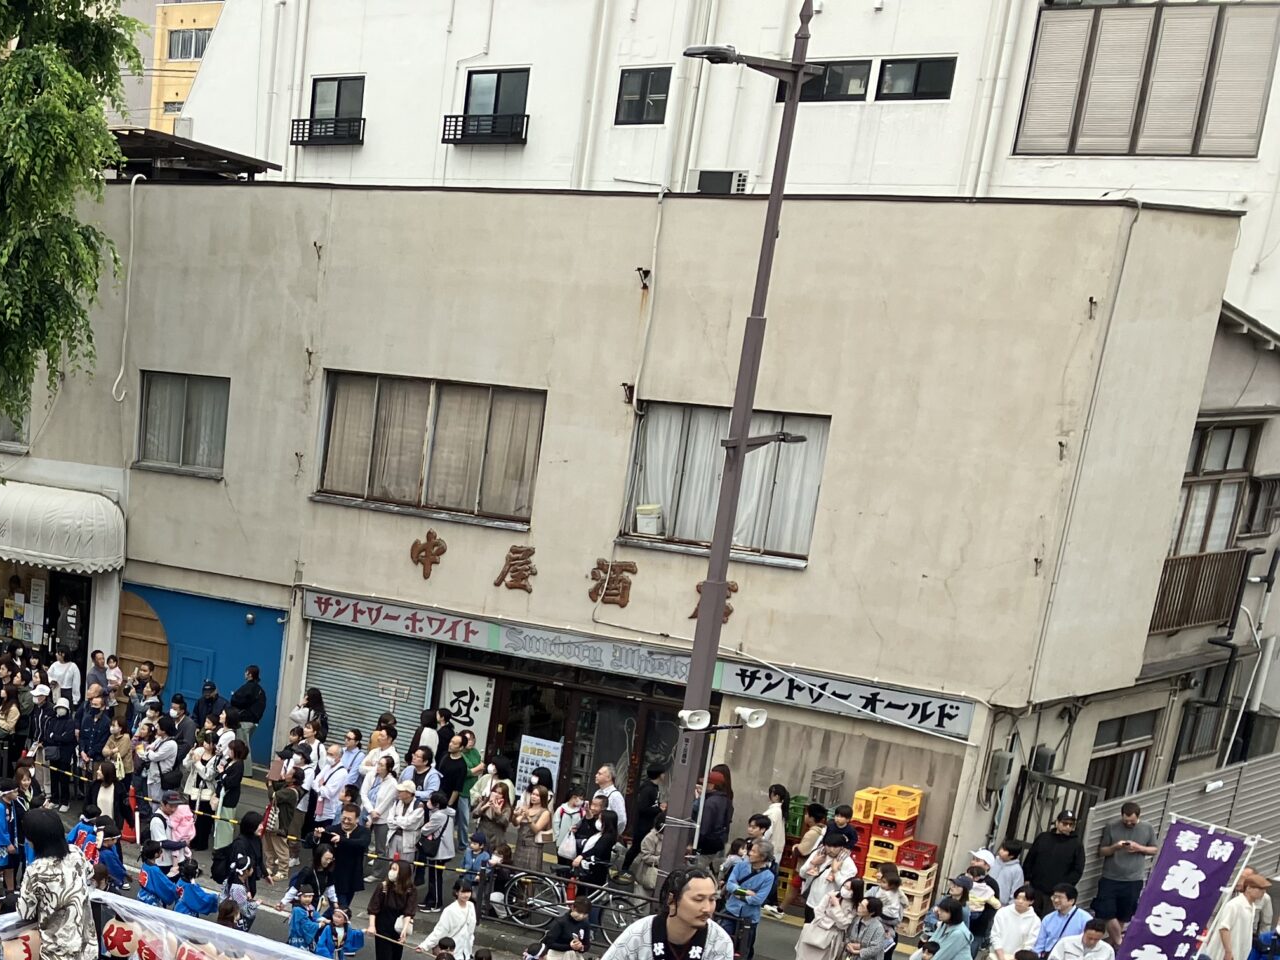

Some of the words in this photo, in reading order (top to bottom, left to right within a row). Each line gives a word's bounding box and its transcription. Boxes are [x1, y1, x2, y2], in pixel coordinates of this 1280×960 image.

[314, 596, 479, 643] サントリーホワイト
[505, 627, 604, 668] Suntory
[736, 667, 961, 729] サントリーオールド
[1175, 829, 1235, 863] 奉納
[104, 924, 133, 955] 伏
